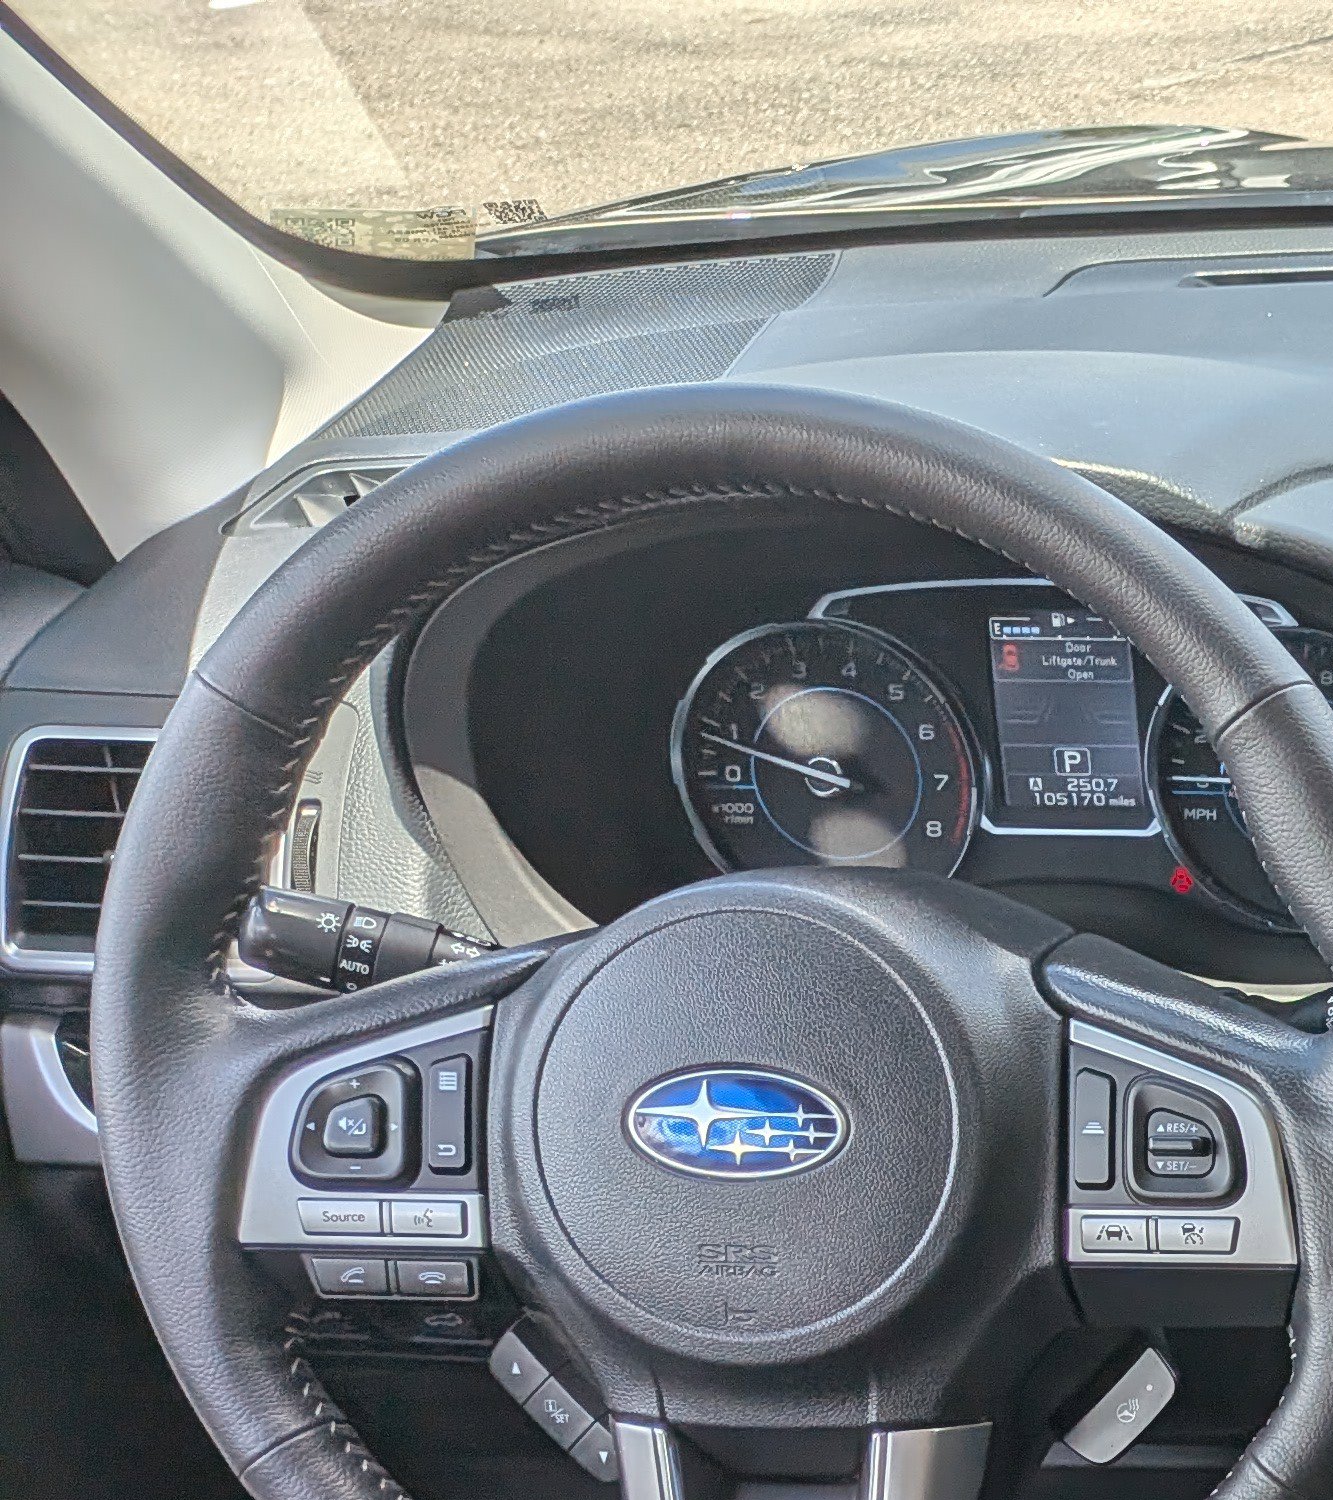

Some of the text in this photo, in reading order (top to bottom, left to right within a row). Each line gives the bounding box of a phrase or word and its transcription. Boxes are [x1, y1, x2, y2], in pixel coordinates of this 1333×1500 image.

[1065, 642, 1092, 653] Door
[841, 661, 858, 679] 4
[1068, 670, 1094, 681] Open
[888, 684, 905, 700] 5
[918, 724, 935, 740] 6
[1064, 751, 1081, 772] P
[724, 766, 741, 782] 0
[934, 774, 949, 790] 7
[1067, 778, 1118, 792] 250.7
[1035, 792, 1136, 806] 105170 miles
[1184, 808, 1217, 821] MPH
[926, 820, 943, 838] 8
[339, 958, 370, 975] AUTO
[322, 1210, 366, 1223] Source
[698, 1244, 778, 1260] SRS
[698, 1264, 780, 1278] AIRBAG
